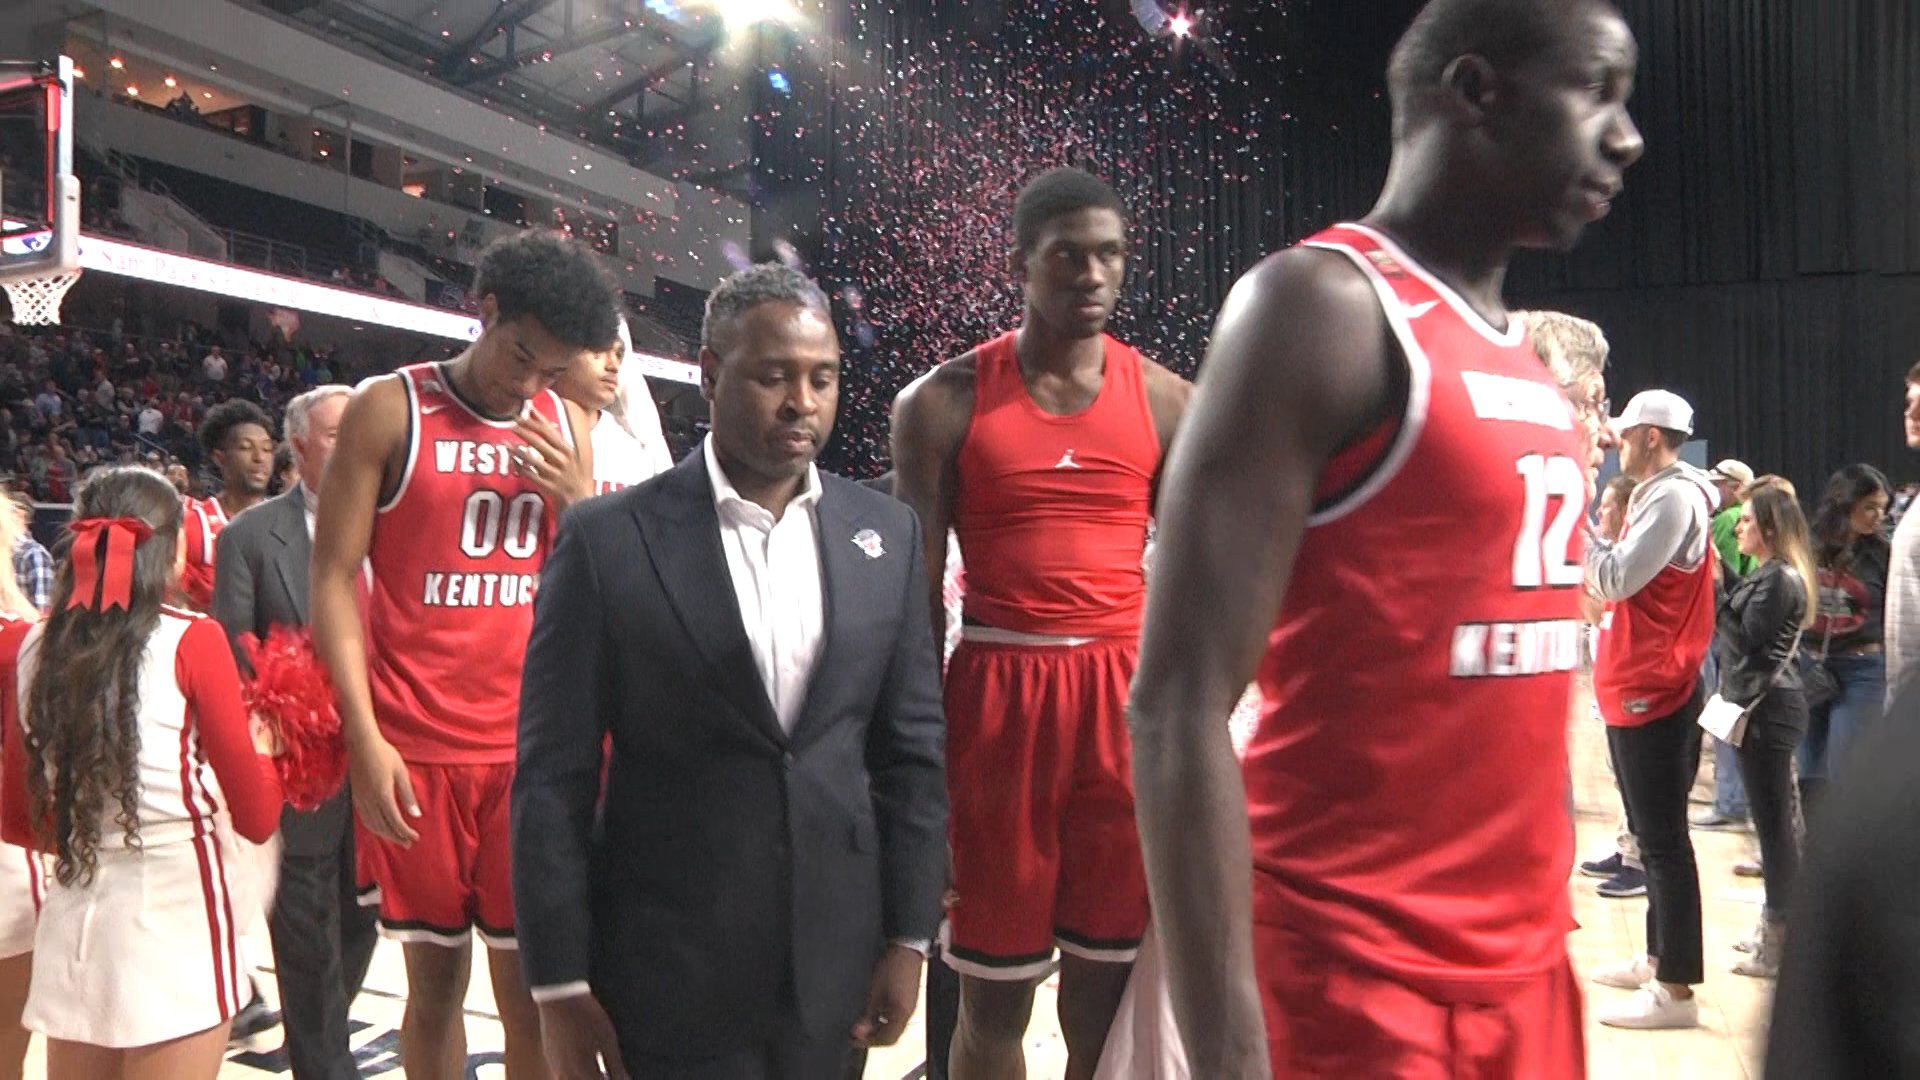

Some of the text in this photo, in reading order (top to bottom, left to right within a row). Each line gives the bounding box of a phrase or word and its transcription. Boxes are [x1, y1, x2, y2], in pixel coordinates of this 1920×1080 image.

[434, 440, 521, 476] WEST
[460, 489, 545, 559] 00
[1512, 451, 1585, 590] 12
